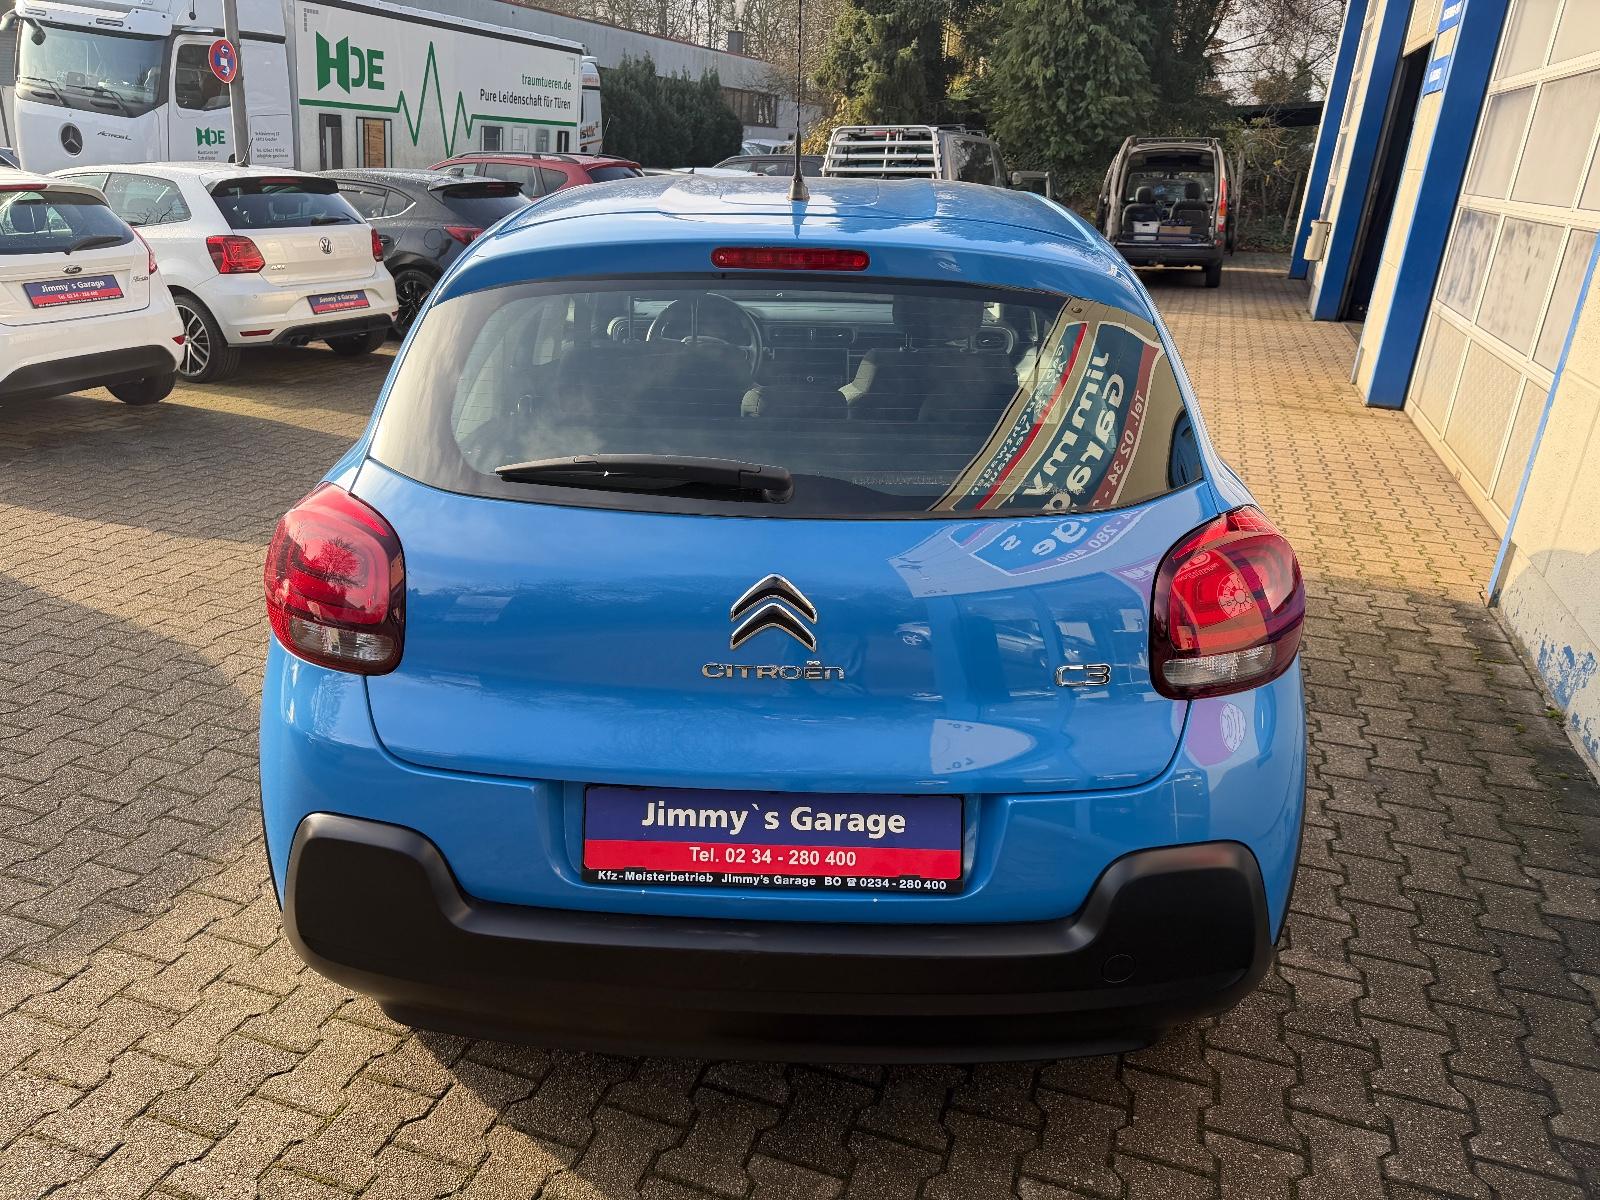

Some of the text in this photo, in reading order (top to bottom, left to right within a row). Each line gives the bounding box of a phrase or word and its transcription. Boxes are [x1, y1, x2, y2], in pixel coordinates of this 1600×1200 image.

[521, 74, 571, 90] traumtueren.de
[480, 88, 571, 110] Pure Leidenschaft für Türen
[196, 127, 226, 147] HDE
[77, 279, 105, 290] Garage
[1055, 663, 1112, 687] C3
[790, 806, 907, 840] Garage
[689, 846, 720, 862] Tel.
[725, 848, 746, 864] 02
[751, 848, 773, 864] 34
[788, 850, 820, 865] 280
[824, 851, 857, 867] 400
[721, 873, 770, 886] Jimmy's
[773, 875, 817, 887] Garage
[824, 876, 842, 886] BO
[859, 877, 890, 888] 0234
[899, 879, 922, 889] 280
[923, 880, 947, 890] 400
